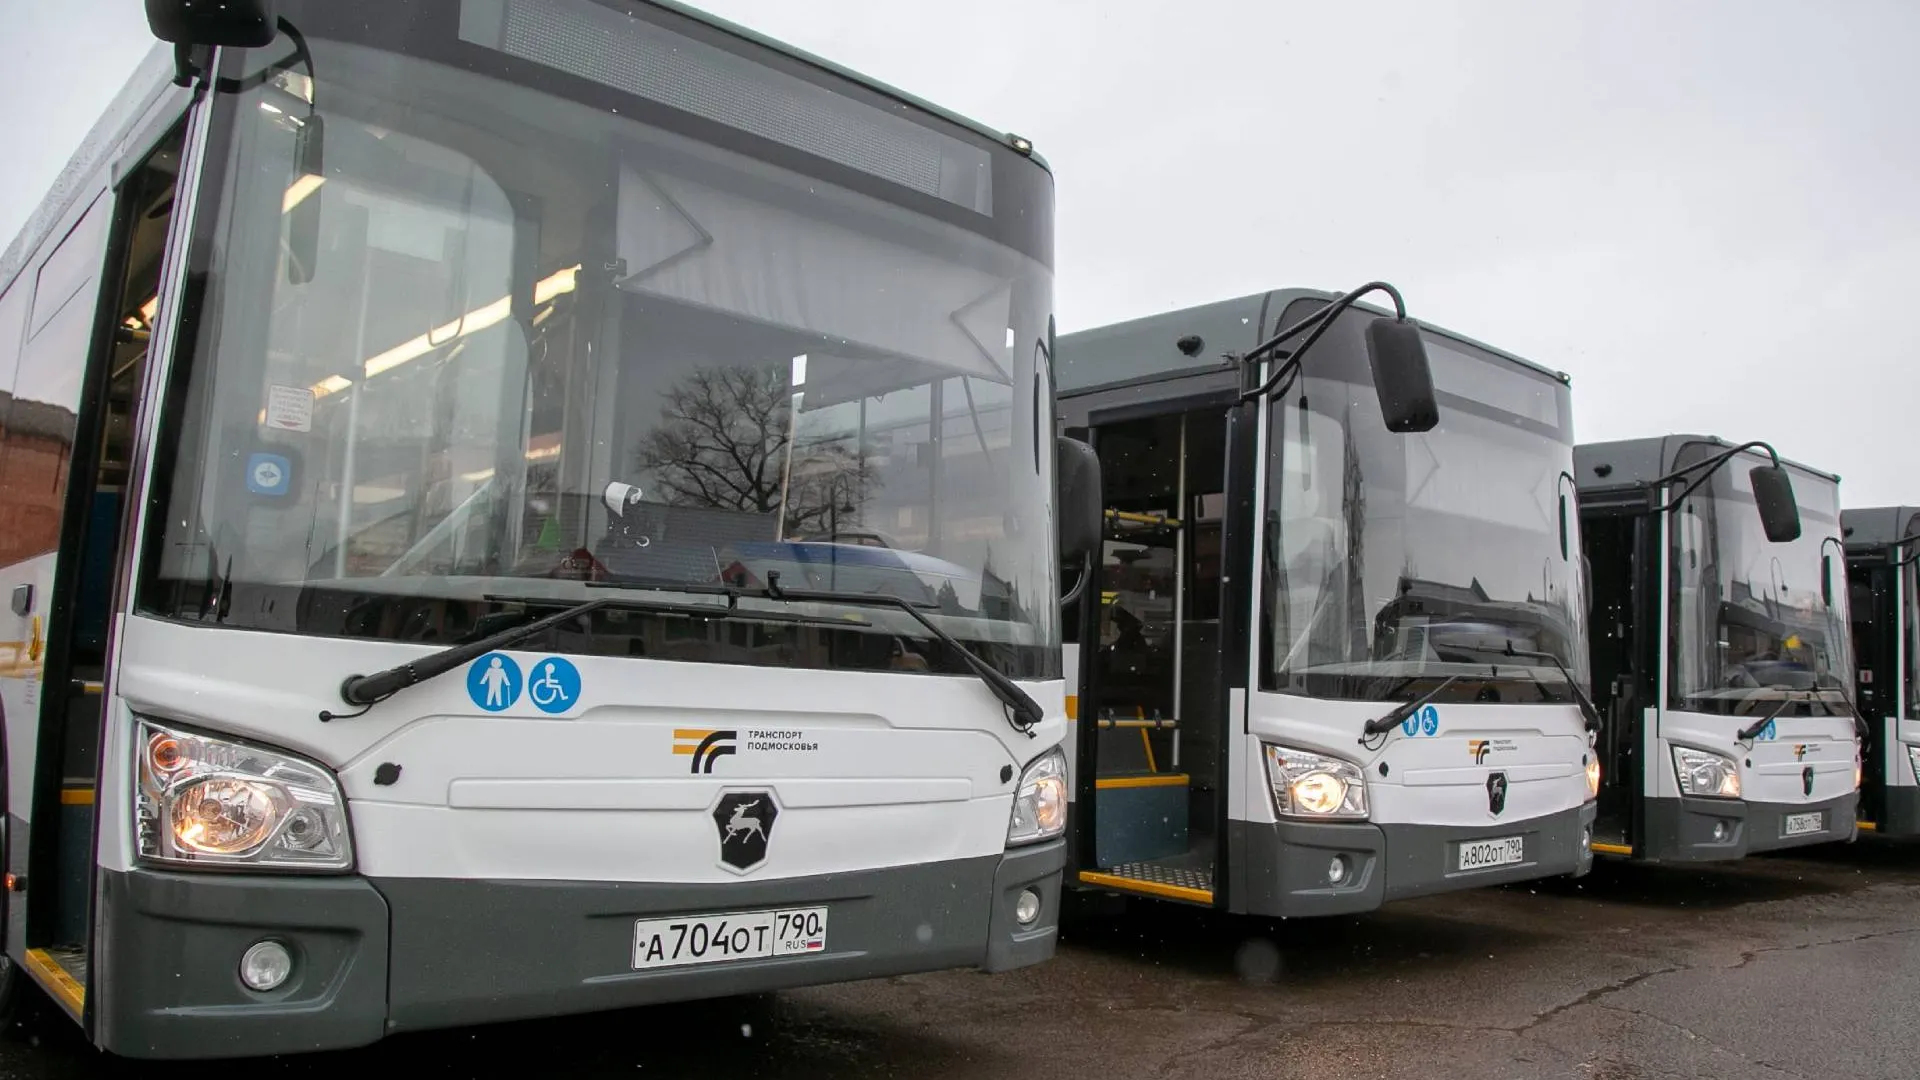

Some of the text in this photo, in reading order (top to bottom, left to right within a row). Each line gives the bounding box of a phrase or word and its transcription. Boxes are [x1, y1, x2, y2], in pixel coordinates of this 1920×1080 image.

[748, 730, 803, 740] ТРАНСПОРТ
[747, 741, 819, 751] ПОДМОСКОВЬЯ
[1463, 839, 1520, 866] А802ОТ 790
[645, 912, 819, 962] А704ОТ 790
[785, 939, 806, 950] RUS
